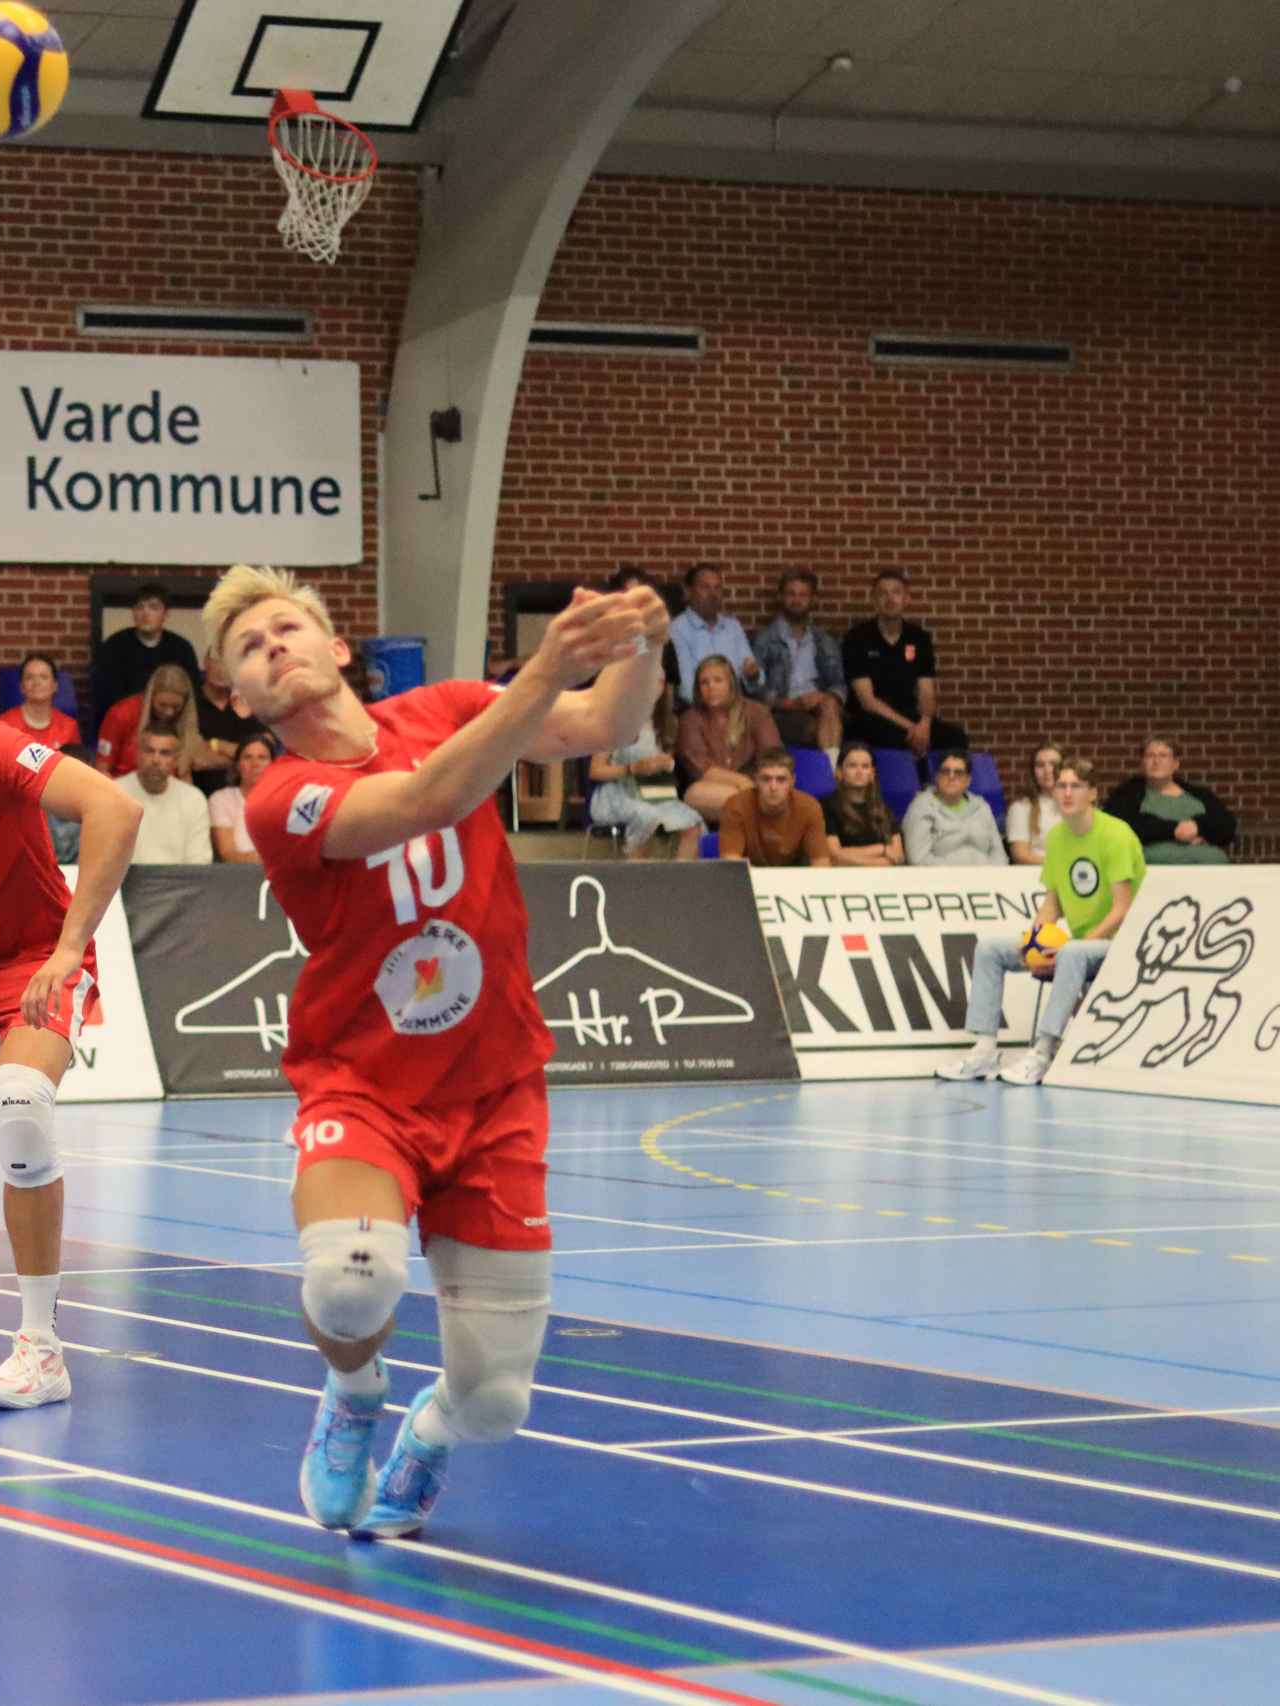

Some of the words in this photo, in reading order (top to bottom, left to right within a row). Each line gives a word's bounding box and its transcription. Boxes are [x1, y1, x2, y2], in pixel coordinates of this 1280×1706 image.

[20, 386, 200, 444] Varde
[25, 456, 341, 516] Kommune
[639, 986, 685, 1046] P
[299, 1120, 345, 1153] 10
